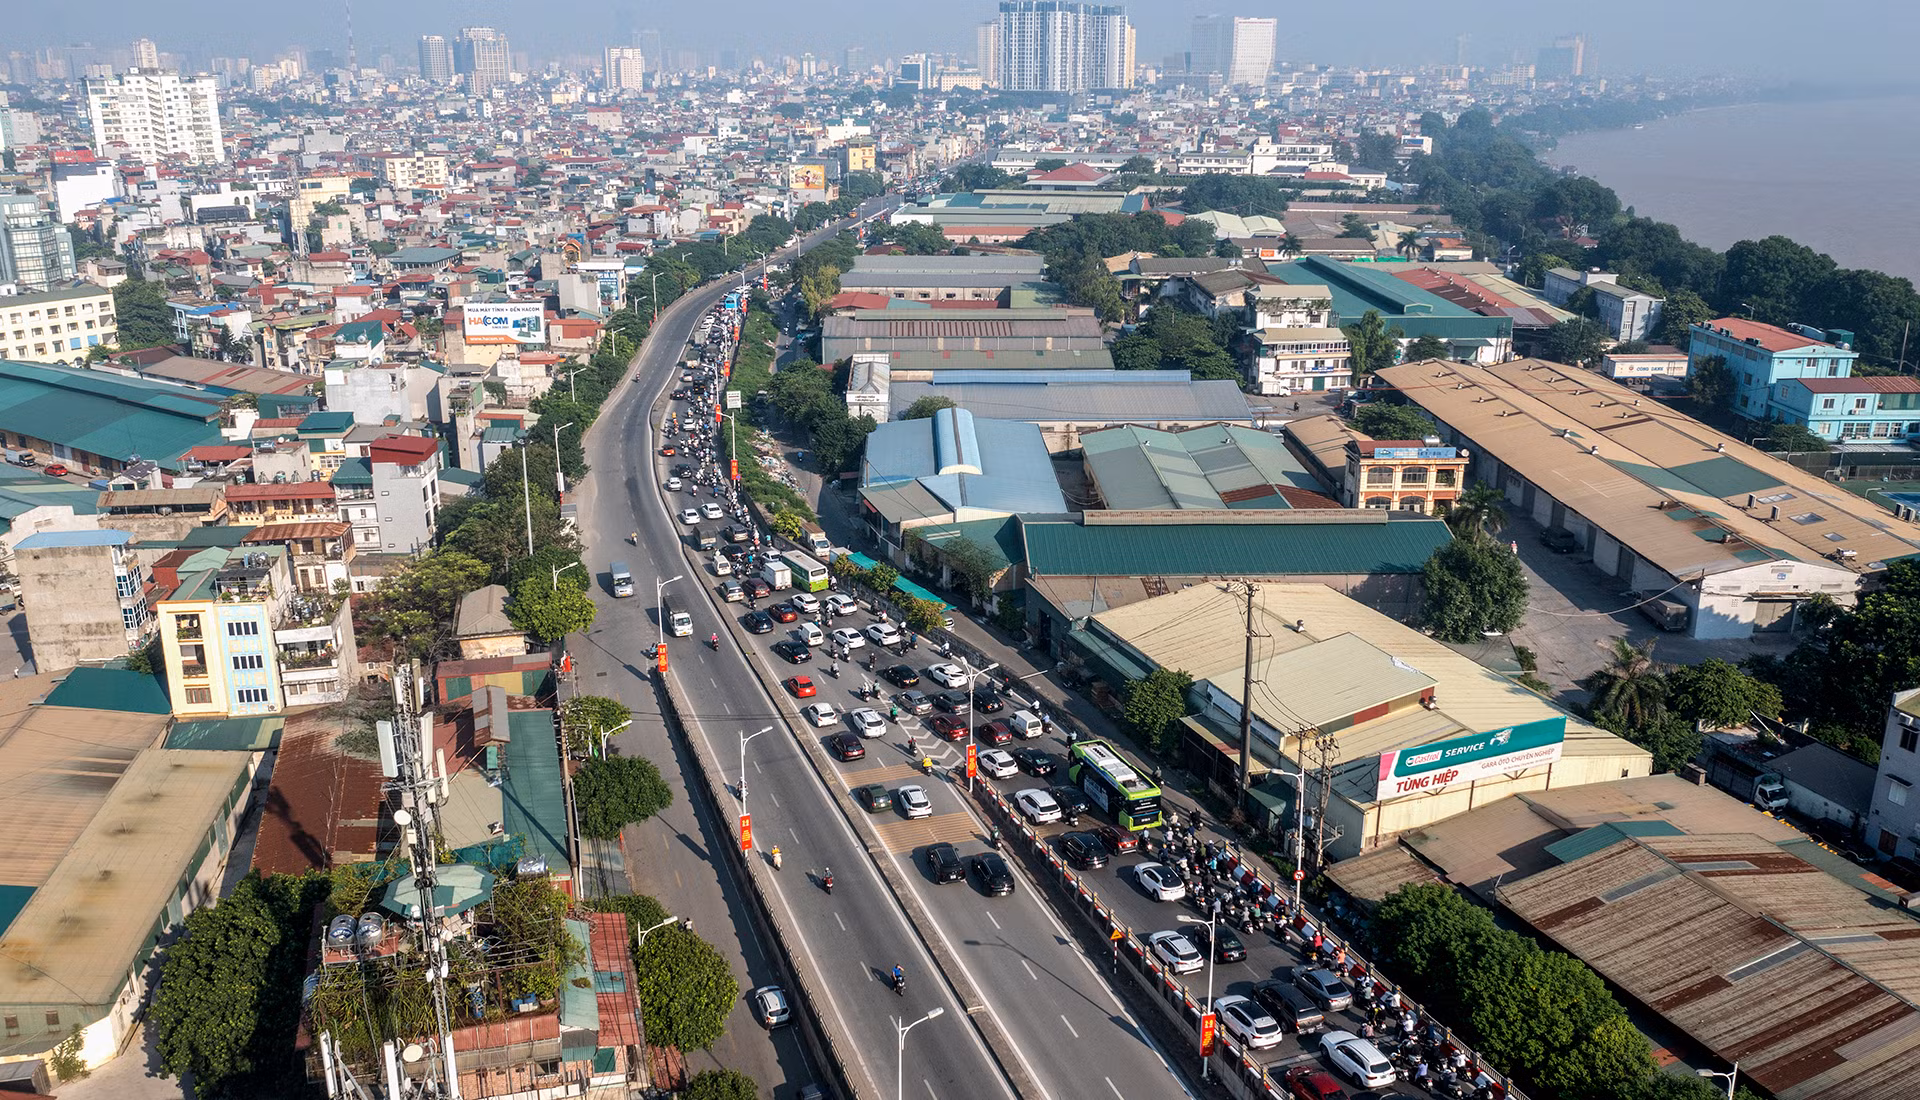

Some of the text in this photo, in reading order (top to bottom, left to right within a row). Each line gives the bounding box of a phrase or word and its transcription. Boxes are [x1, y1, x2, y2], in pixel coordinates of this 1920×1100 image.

[1414, 741, 1486, 764] Castrol SERVICE
[1481, 760, 1498, 769] GARA
[1511, 752, 1534, 763] CHUYÊN
[1534, 747, 1555, 759] NGHIỆP
[1396, 768, 1459, 793] TÙNG HIỆP
